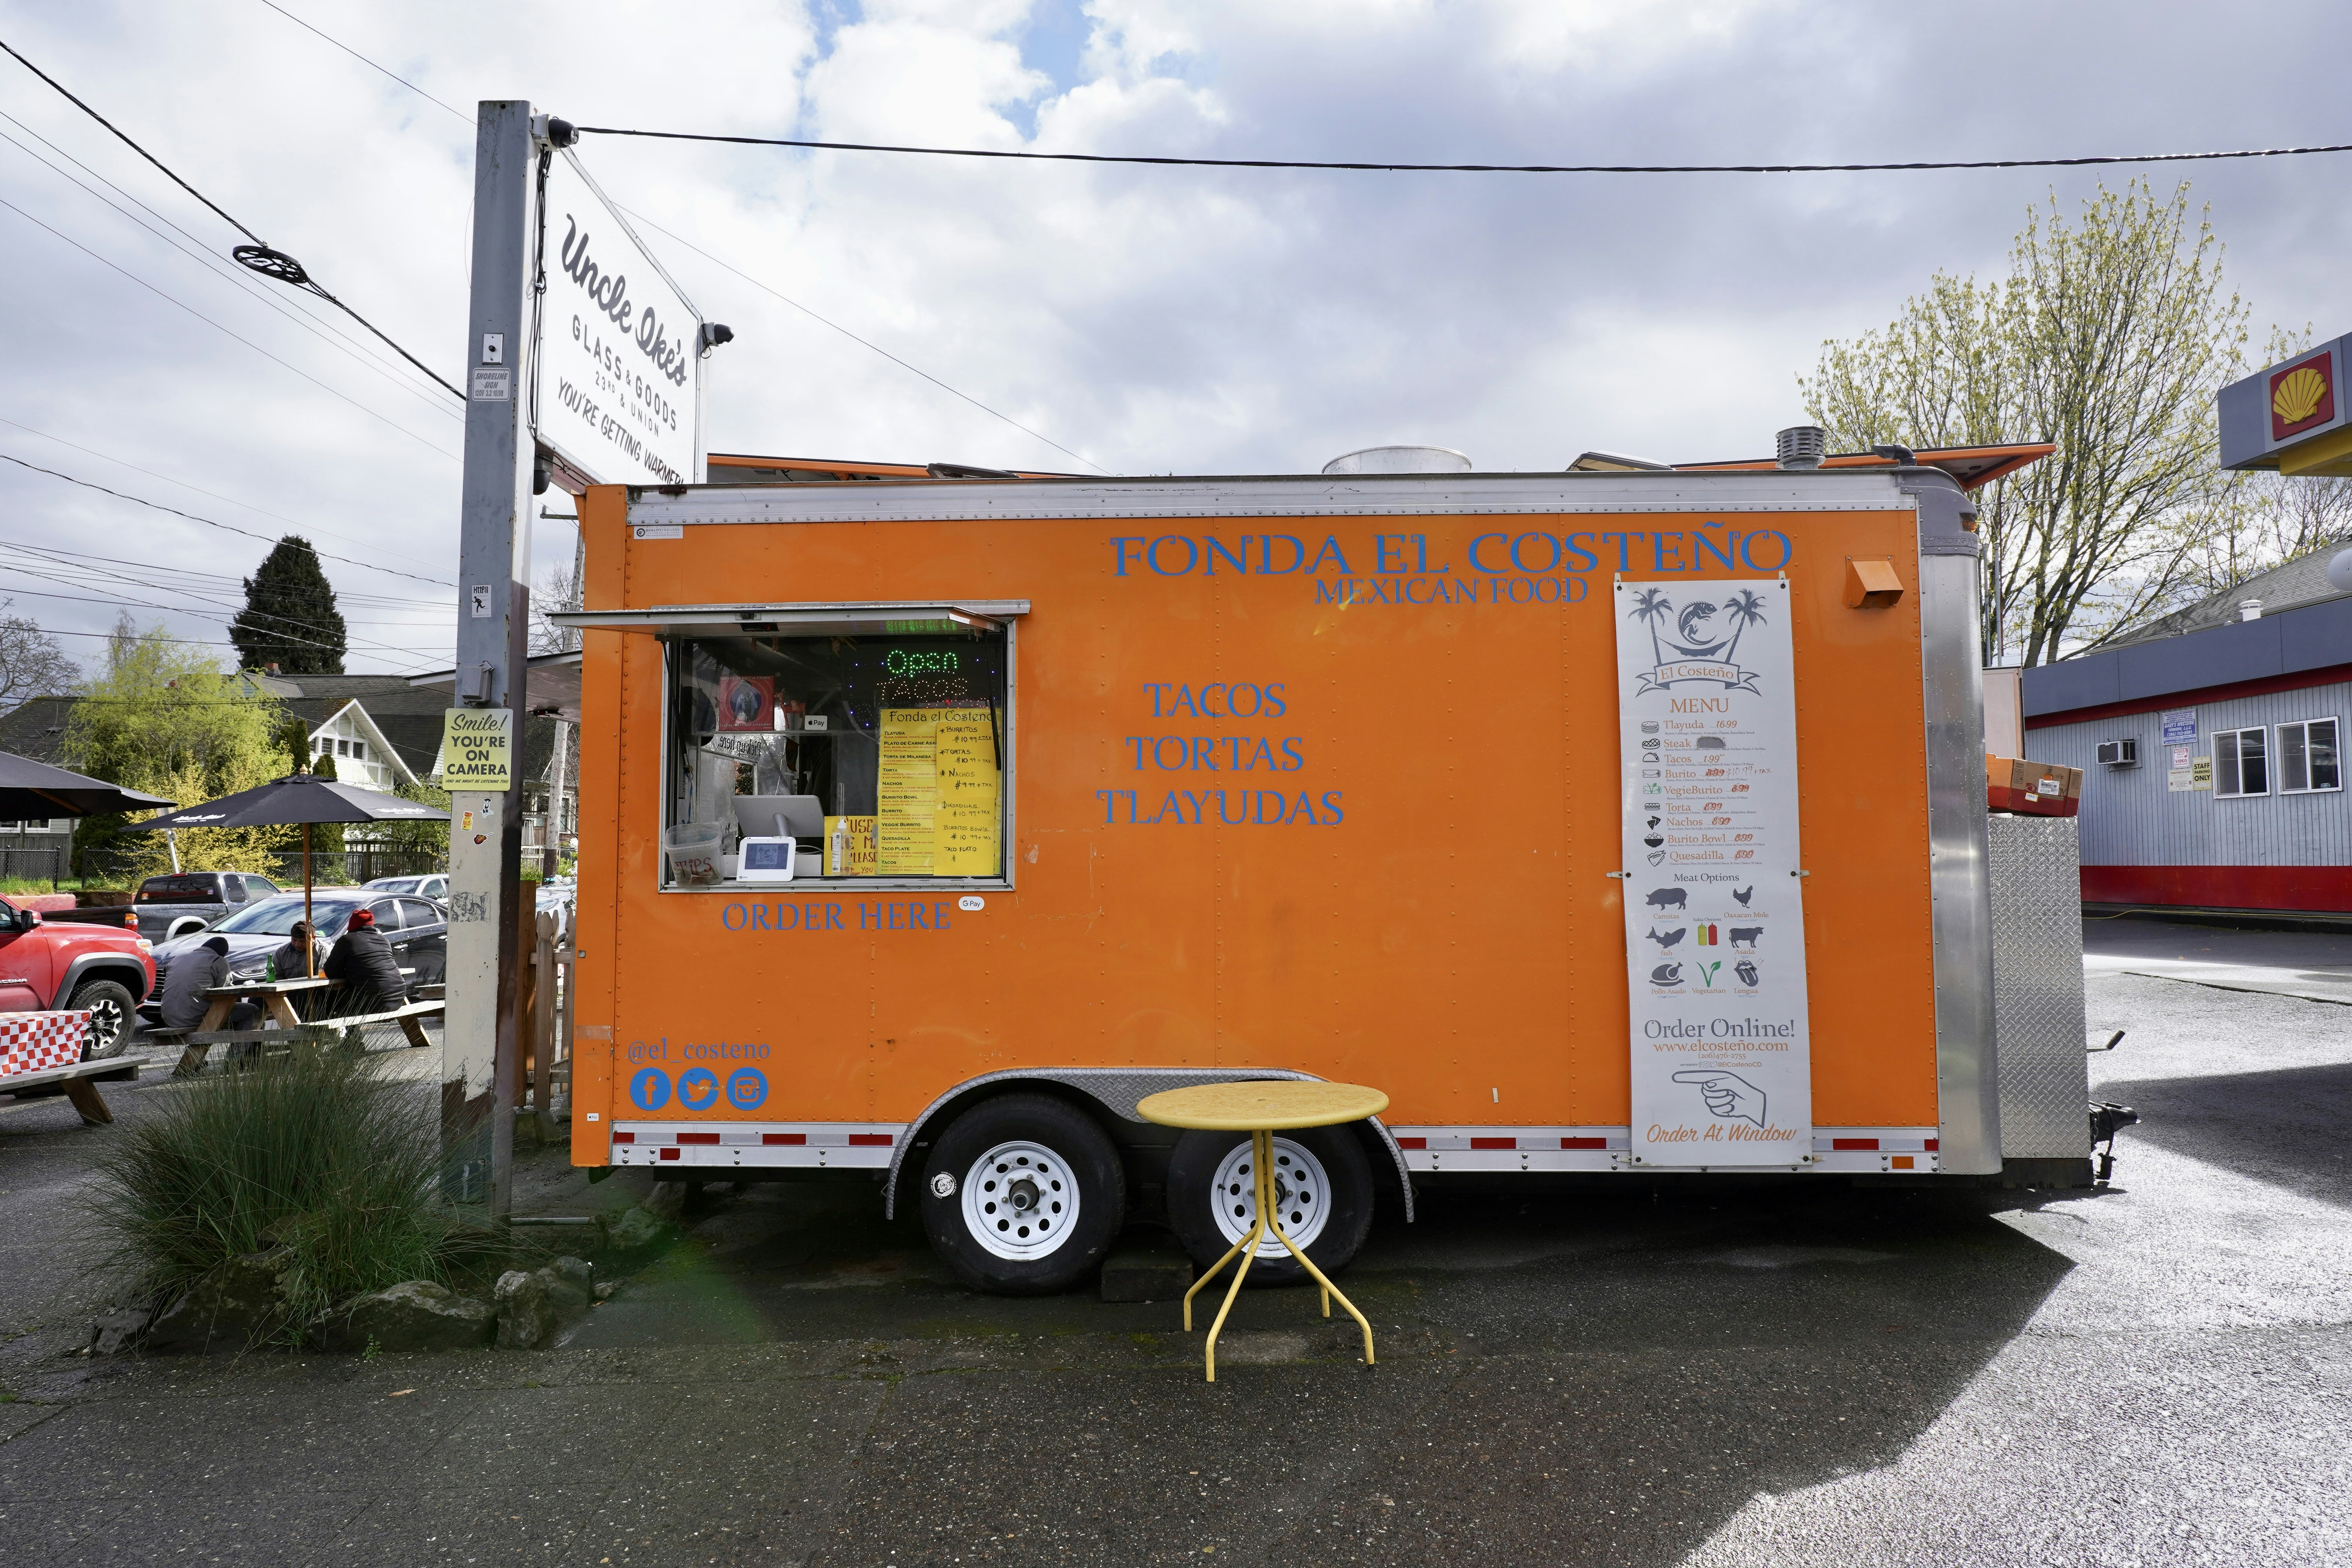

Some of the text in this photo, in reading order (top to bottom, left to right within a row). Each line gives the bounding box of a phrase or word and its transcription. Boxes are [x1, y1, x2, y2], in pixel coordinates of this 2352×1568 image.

[562, 213, 687, 387] Uncle Ike's
[572, 314, 676, 432] GLASS & GOODS
[493, 389, 504, 397] 10/98
[595, 370, 659, 438] 23RD & UNION
[558, 376, 600, 427] YOU'RE
[601, 414, 641, 462] GETTING
[1110, 521, 1793, 577] FONDA EL COSTEÑO
[1314, 577, 1588, 605] MEXICAN FOOD
[887, 650, 957, 678] Open
[1660, 664, 1734, 681] El Costeño
[876, 678, 968, 700] TACOS
[1143, 682, 1287, 718] TACOS
[1670, 698, 1729, 713] MENU
[450, 713, 508, 731] Smile!
[889, 710, 927, 722] Fonda
[931, 711, 940, 722] el
[1663, 720, 1704, 731] Tlayuda
[451, 736, 505, 748] YOU'RE
[1664, 738, 1691, 748] Steak
[466, 750, 489, 761] ON
[1125, 735, 1305, 772] TORTAS
[1664, 754, 1691, 763] Tacos
[447, 764, 508, 775] CAMERA
[1665, 769, 1696, 778] Burito
[1663, 785, 1722, 797] VegieBurito
[1095, 789, 1345, 826] TLAYUDAS
[1666, 803, 1691, 811] Torta
[1666, 817, 1703, 826] Nachos
[1668, 834, 1699, 843] Burito
[1701, 833, 1726, 843] Bowl
[1670, 851, 1724, 862] Quesadilla
[1673, 873, 1740, 884] Meat Options
[722, 902, 950, 931] ORDER HERE
[1644, 1018, 1795, 1039] Order Online!
[628, 1037, 771, 1064] @el_costeno
[1653, 1039, 1789, 1052] www.elcosteño.com
[1698, 1052, 1746, 1060] (206)476-2755
[1646, 1123, 1797, 1143] Order At Window
